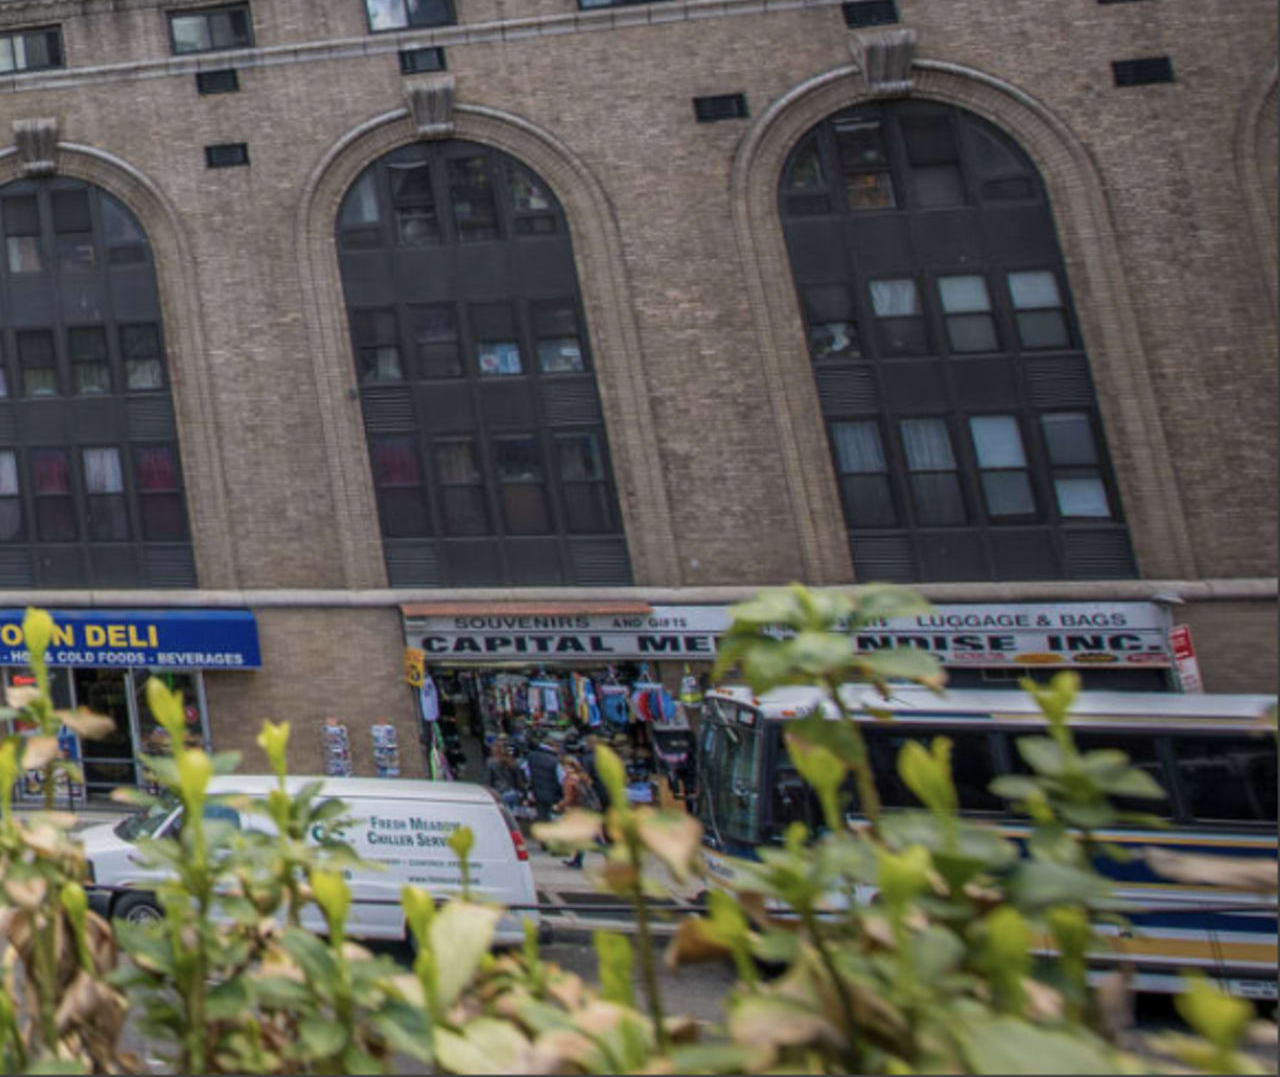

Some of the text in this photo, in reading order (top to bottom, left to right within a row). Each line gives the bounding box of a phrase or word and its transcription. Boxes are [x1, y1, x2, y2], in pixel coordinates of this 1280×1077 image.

[454, 617, 687, 629] SOUVENIRS AND GIFTS
[917, 613, 1128, 628] LUGGAGE & BAGS
[85, 624, 159, 648] DELI
[421, 634, 1163, 653] CAPITAL MENDISE INC.
[57, 651, 95, 663] COLD
[98, 652, 145, 664] FOODS
[157, 652, 244, 665] BEVERAGES
[369, 816, 406, 830] FRESH
[366, 830, 414, 846] CHILLER
